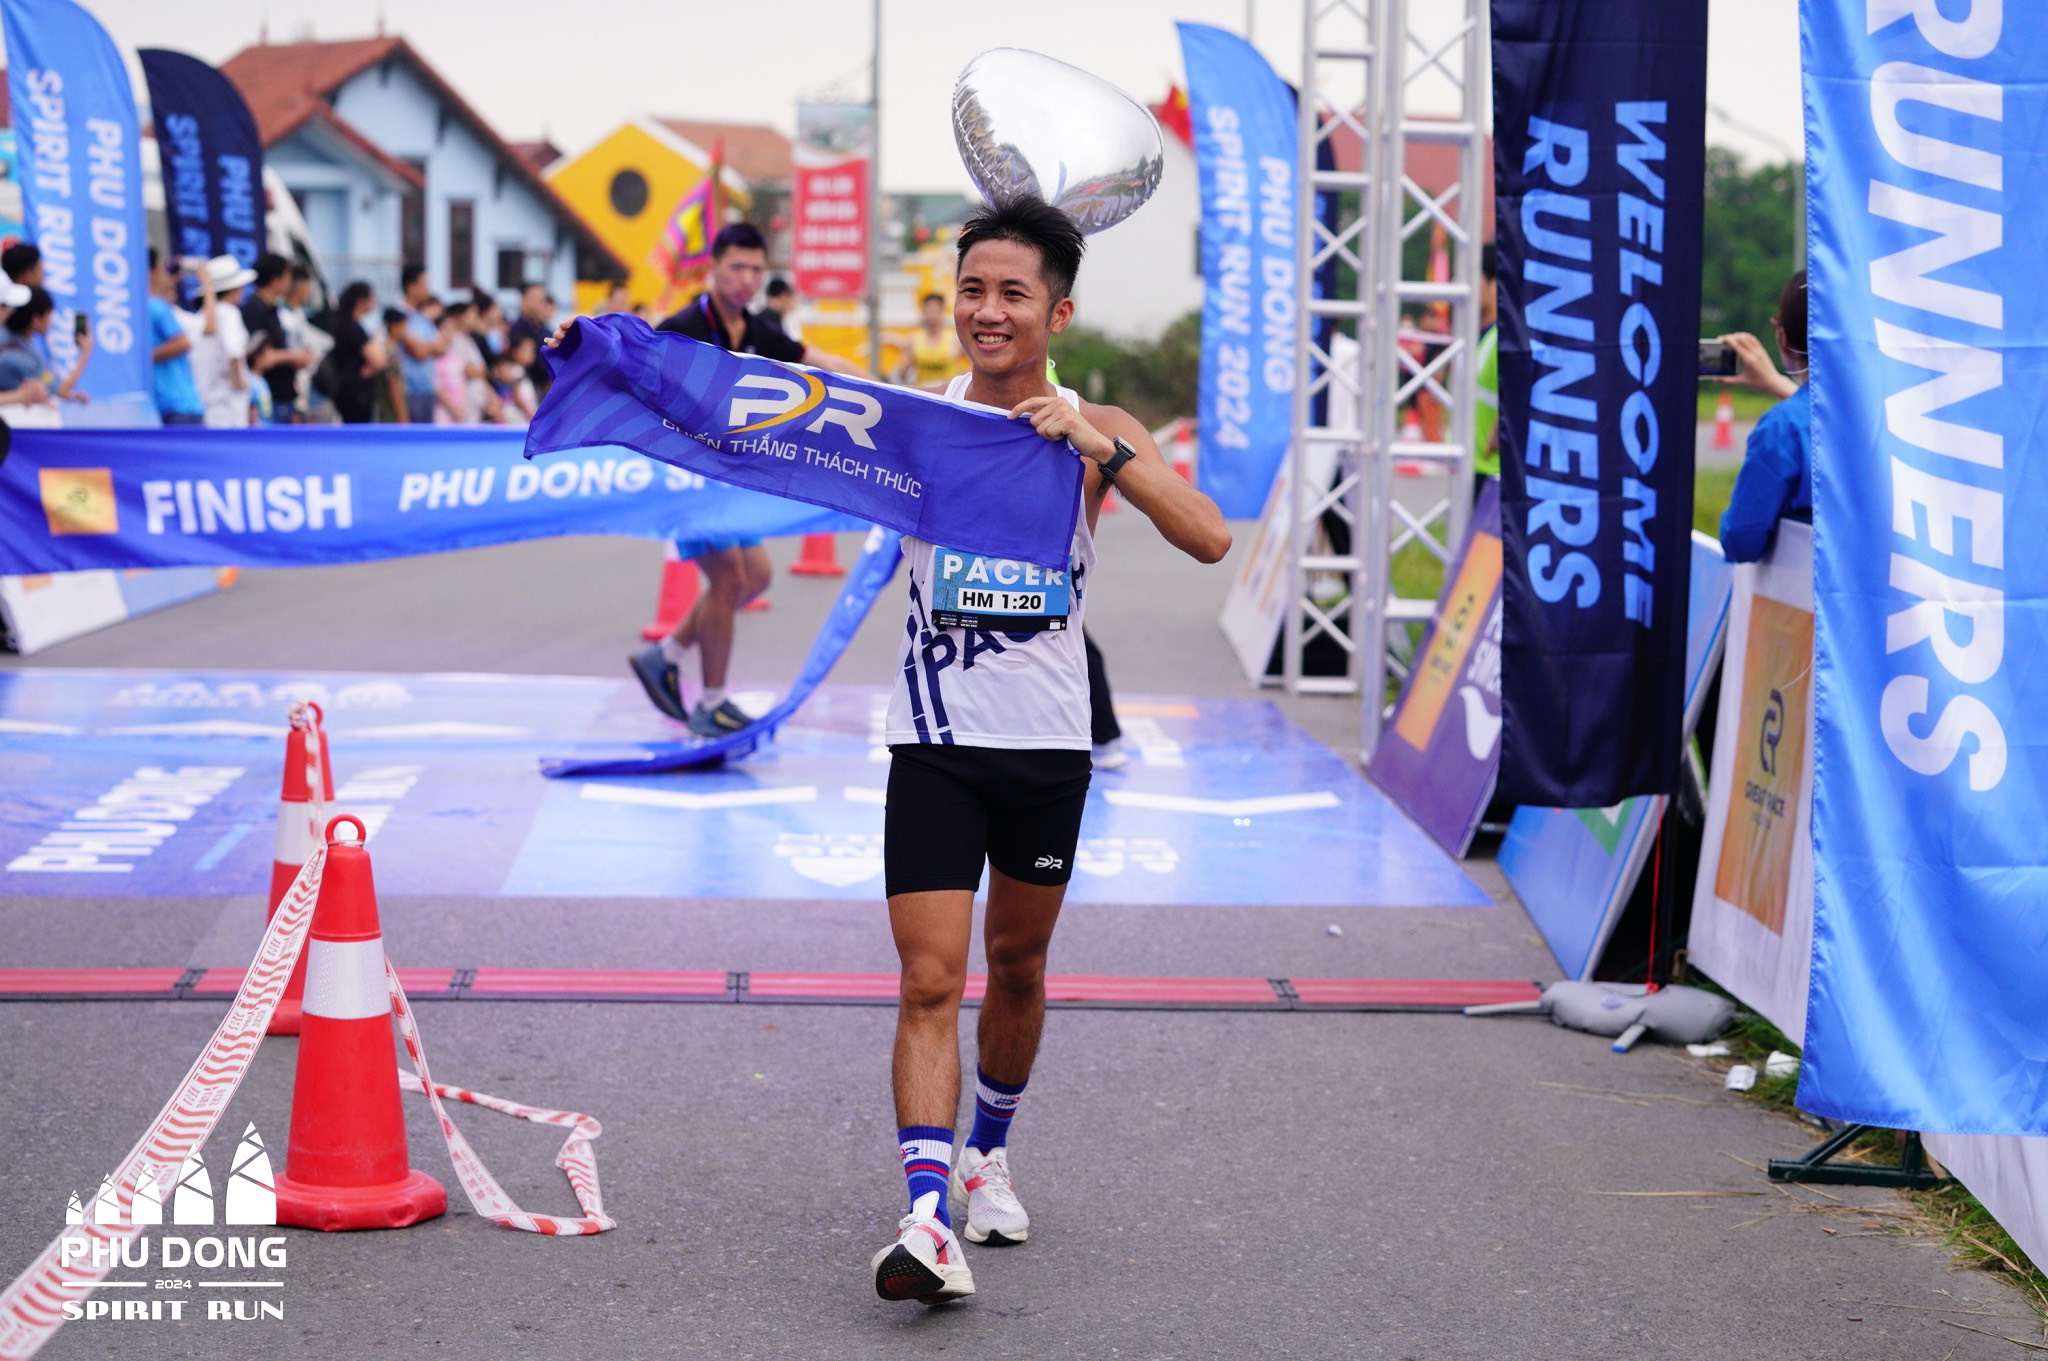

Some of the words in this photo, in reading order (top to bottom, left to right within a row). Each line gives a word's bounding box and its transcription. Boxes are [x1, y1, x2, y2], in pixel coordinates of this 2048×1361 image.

[26, 68, 71, 199] SPIRIT
[86, 117, 126, 209] PHU
[165, 112, 209, 223] SPIRIT
[1207, 103, 1252, 236] SPIRIT
[216, 154, 256, 232] PHU
[1259, 154, 1294, 248] PHU
[36, 202, 78, 296] RUN
[90, 216, 133, 354] DONG
[1218, 243, 1252, 335] RUN
[1261, 255, 1297, 394] DONG
[1520, 115, 1601, 608] RUNNERS
[1615, 101, 1667, 628] WELCOME
[1215, 341, 1251, 448] 2024
[142, 473, 352, 534] FINISH
[398, 466, 496, 512] PHU
[505, 457, 654, 502] DONG
[730, 433, 797, 460] THẮNG
[804, 451, 869, 479] THÁCH
[874, 472, 922, 498] THỨC
[943, 554, 1064, 586] PACER
[962, 591, 994, 608] HM
[1002, 594, 1042, 610] 1:20
